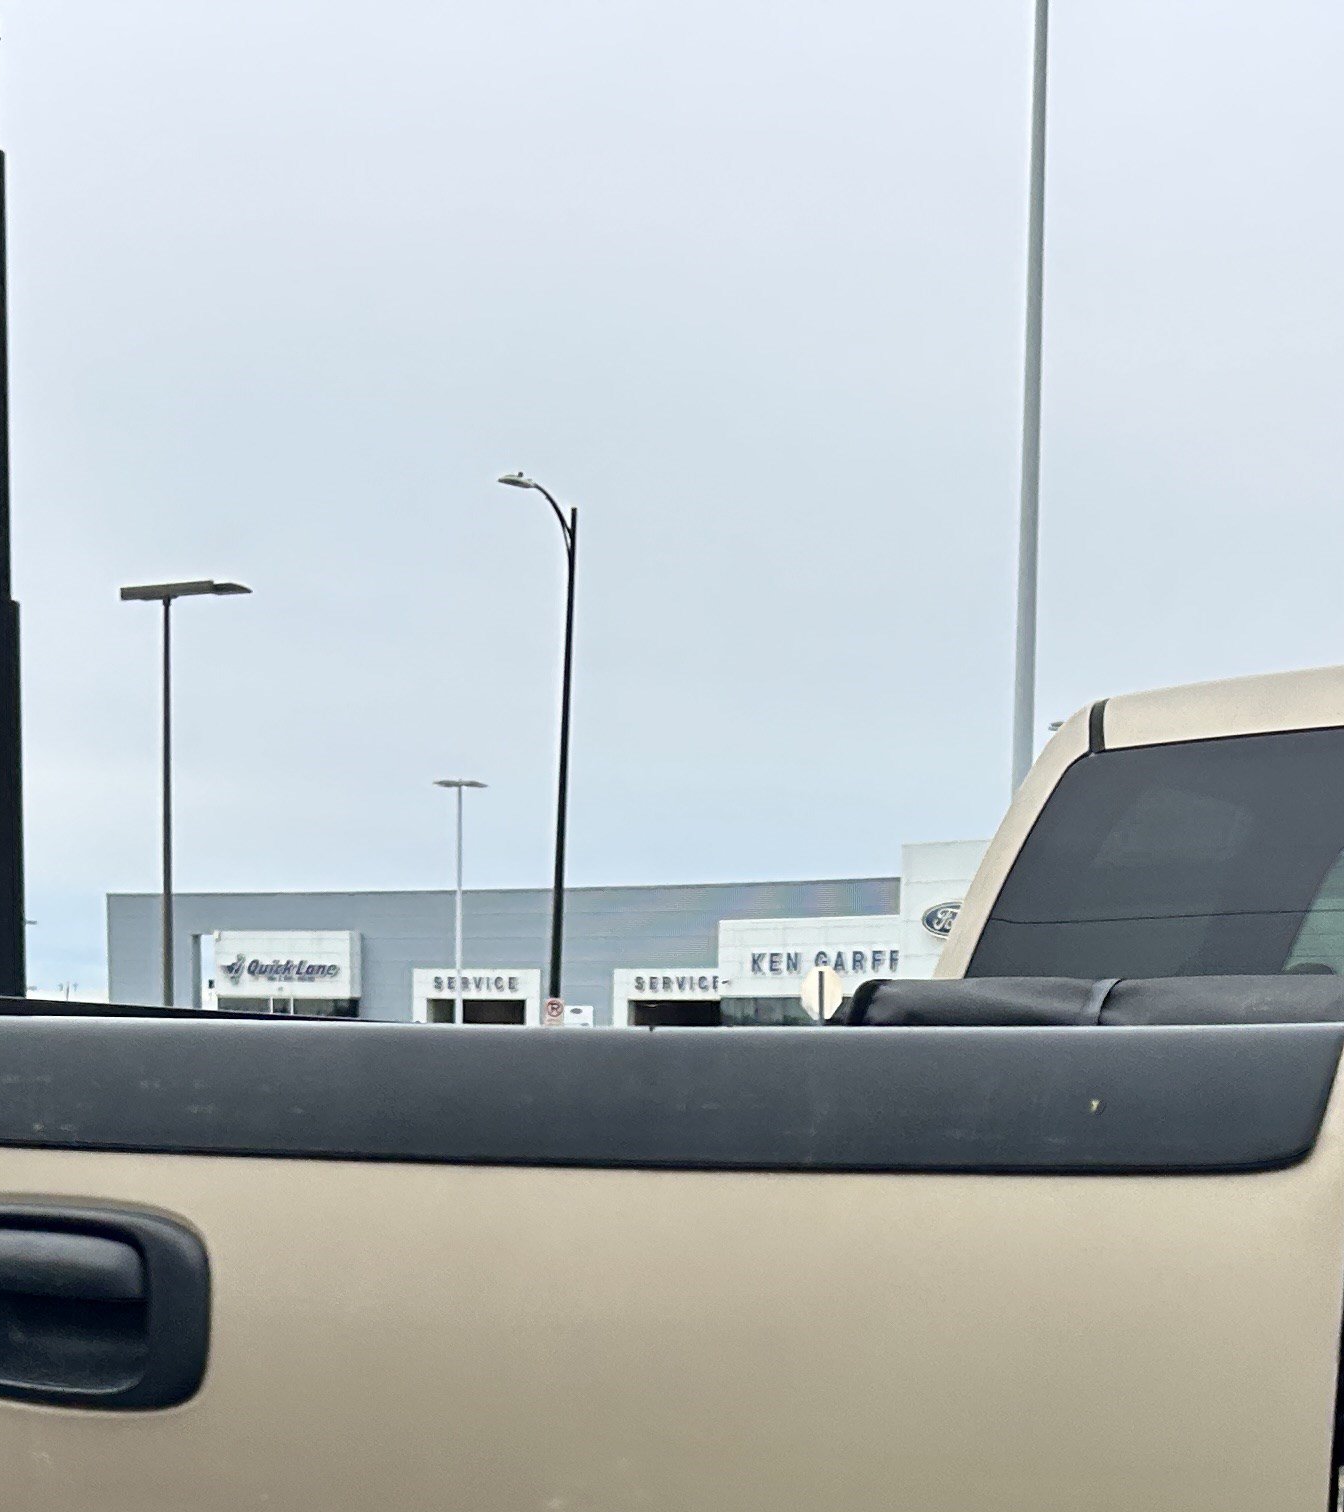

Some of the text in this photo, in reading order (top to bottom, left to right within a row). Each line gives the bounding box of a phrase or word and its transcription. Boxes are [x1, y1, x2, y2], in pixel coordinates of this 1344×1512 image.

[248, 959, 339, 977] Quick Lane
[751, 950, 900, 974] KEN GARFF
[434, 976, 518, 992] SERVICE
